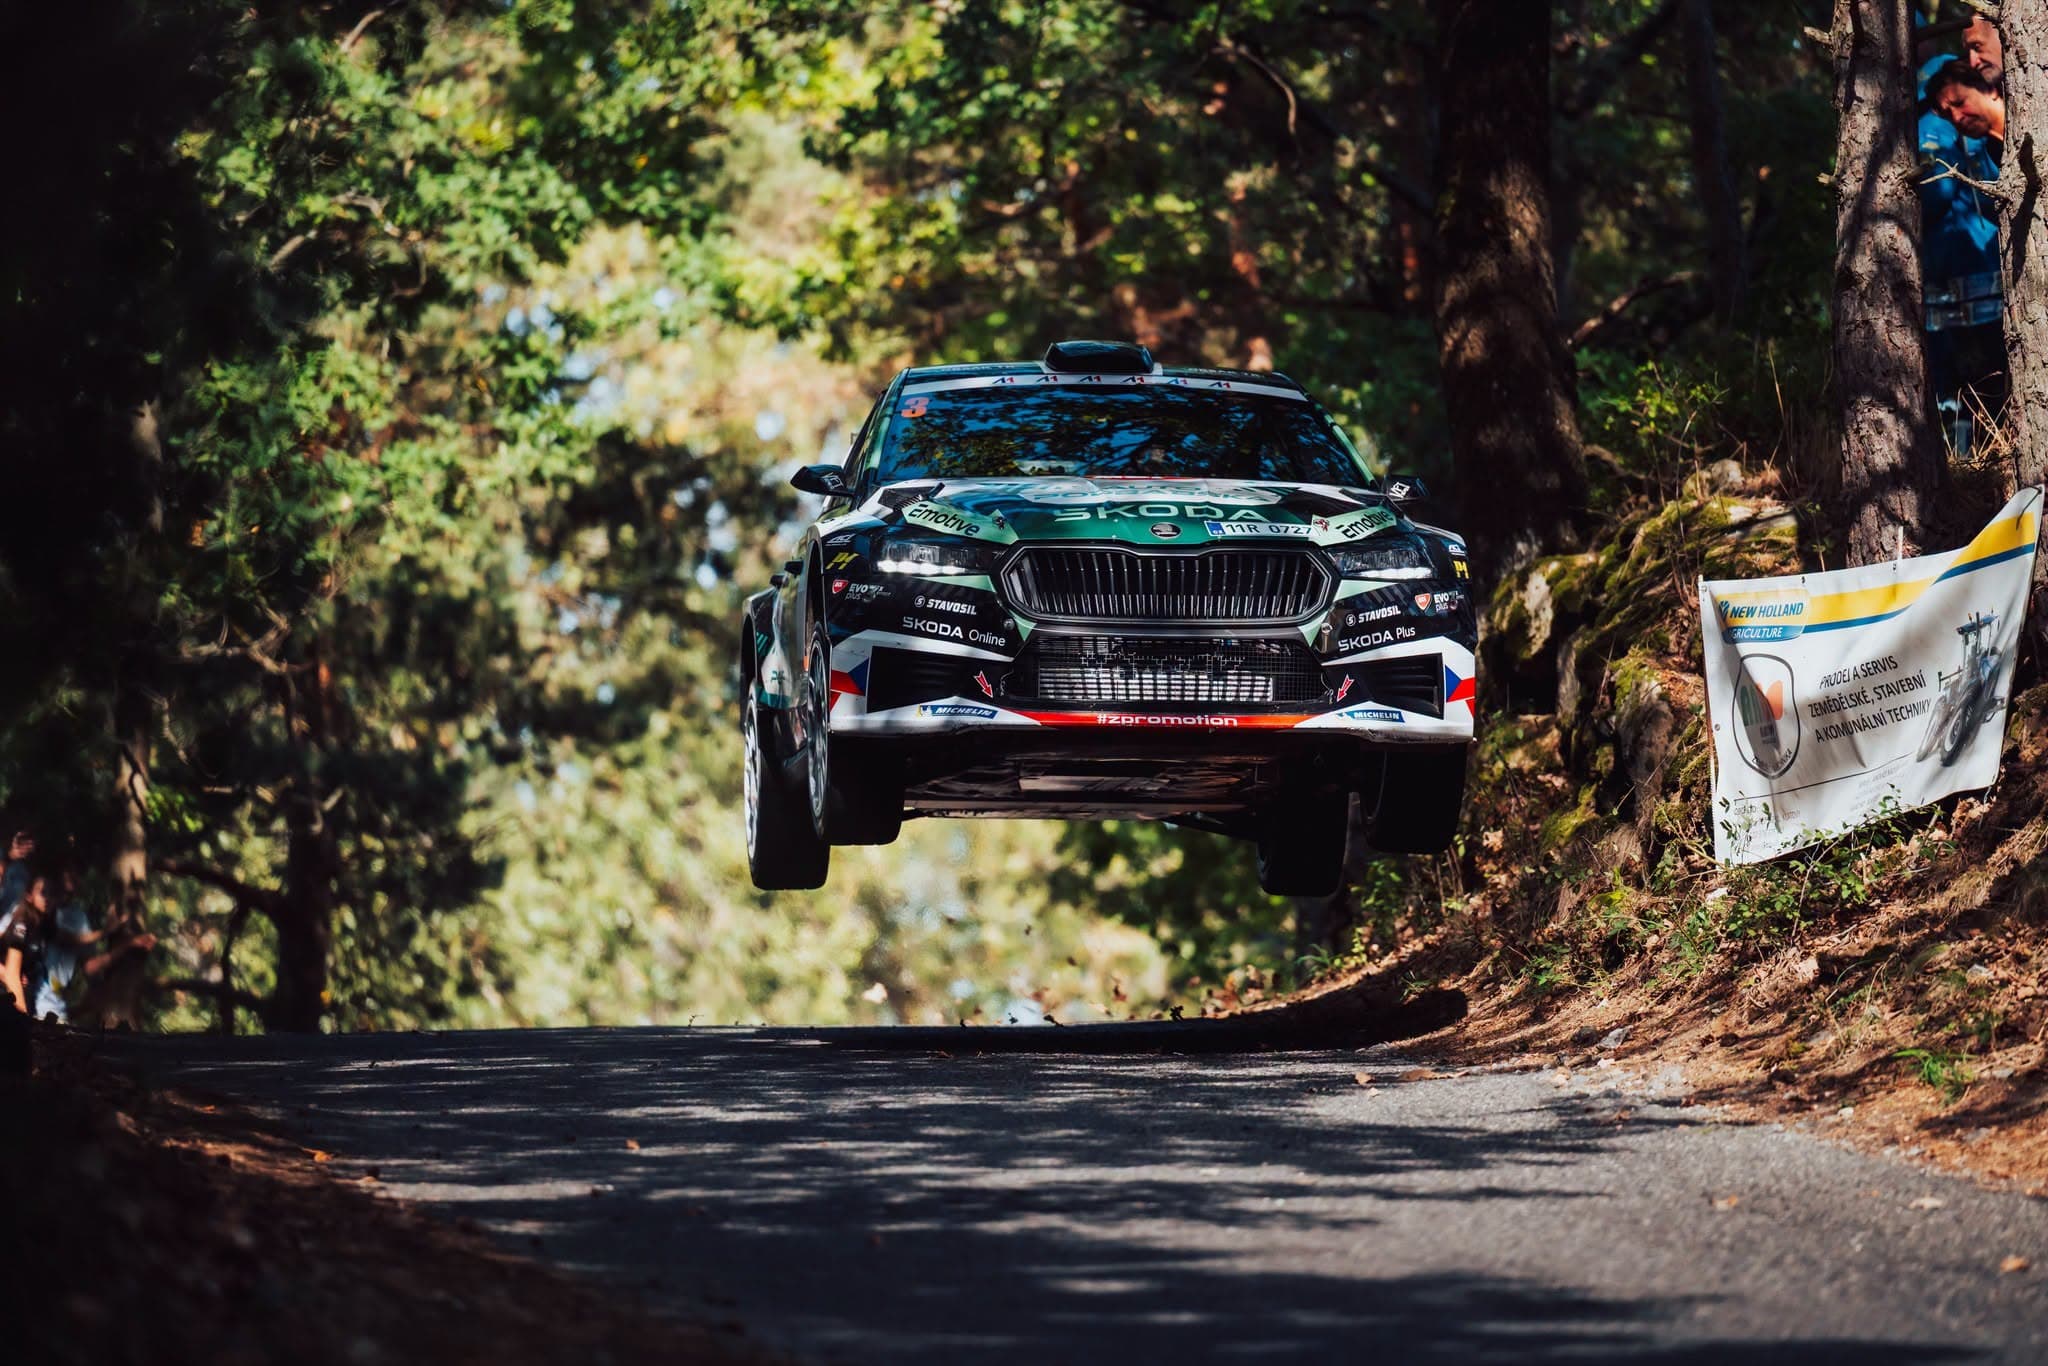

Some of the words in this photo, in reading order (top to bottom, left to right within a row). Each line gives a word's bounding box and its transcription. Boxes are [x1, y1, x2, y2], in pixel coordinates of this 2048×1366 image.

[901, 396, 929, 418] 3
[908, 504, 980, 537] Emotive
[1226, 524, 1259, 534] 11R
[1268, 524, 1312, 535] 0727
[848, 583, 868, 593] EVO
[1433, 592, 1449, 603] EVO
[926, 598, 977, 616] STAVOSIL
[1358, 605, 1401, 623] STAVOSIL
[1729, 606, 1757, 618] NEW
[1757, 602, 1804, 618] HOLLAND
[968, 629, 1006, 646] Online
[1396, 626, 1416, 639] Plus
[1730, 627, 1784, 639] GRICULTURE
[1853, 666, 1861, 680] A
[1860, 655, 1898, 678] SERVIS
[1873, 669, 1927, 701] STAVEBNÍ
[935, 706, 992, 717] MICHELIN
[1353, 711, 1400, 720] MICHELIN
[1096, 714, 1238, 727] #zpromotion
[1815, 728, 1824, 743] A
[1823, 708, 1888, 741] KOMUNÁLNÍ
